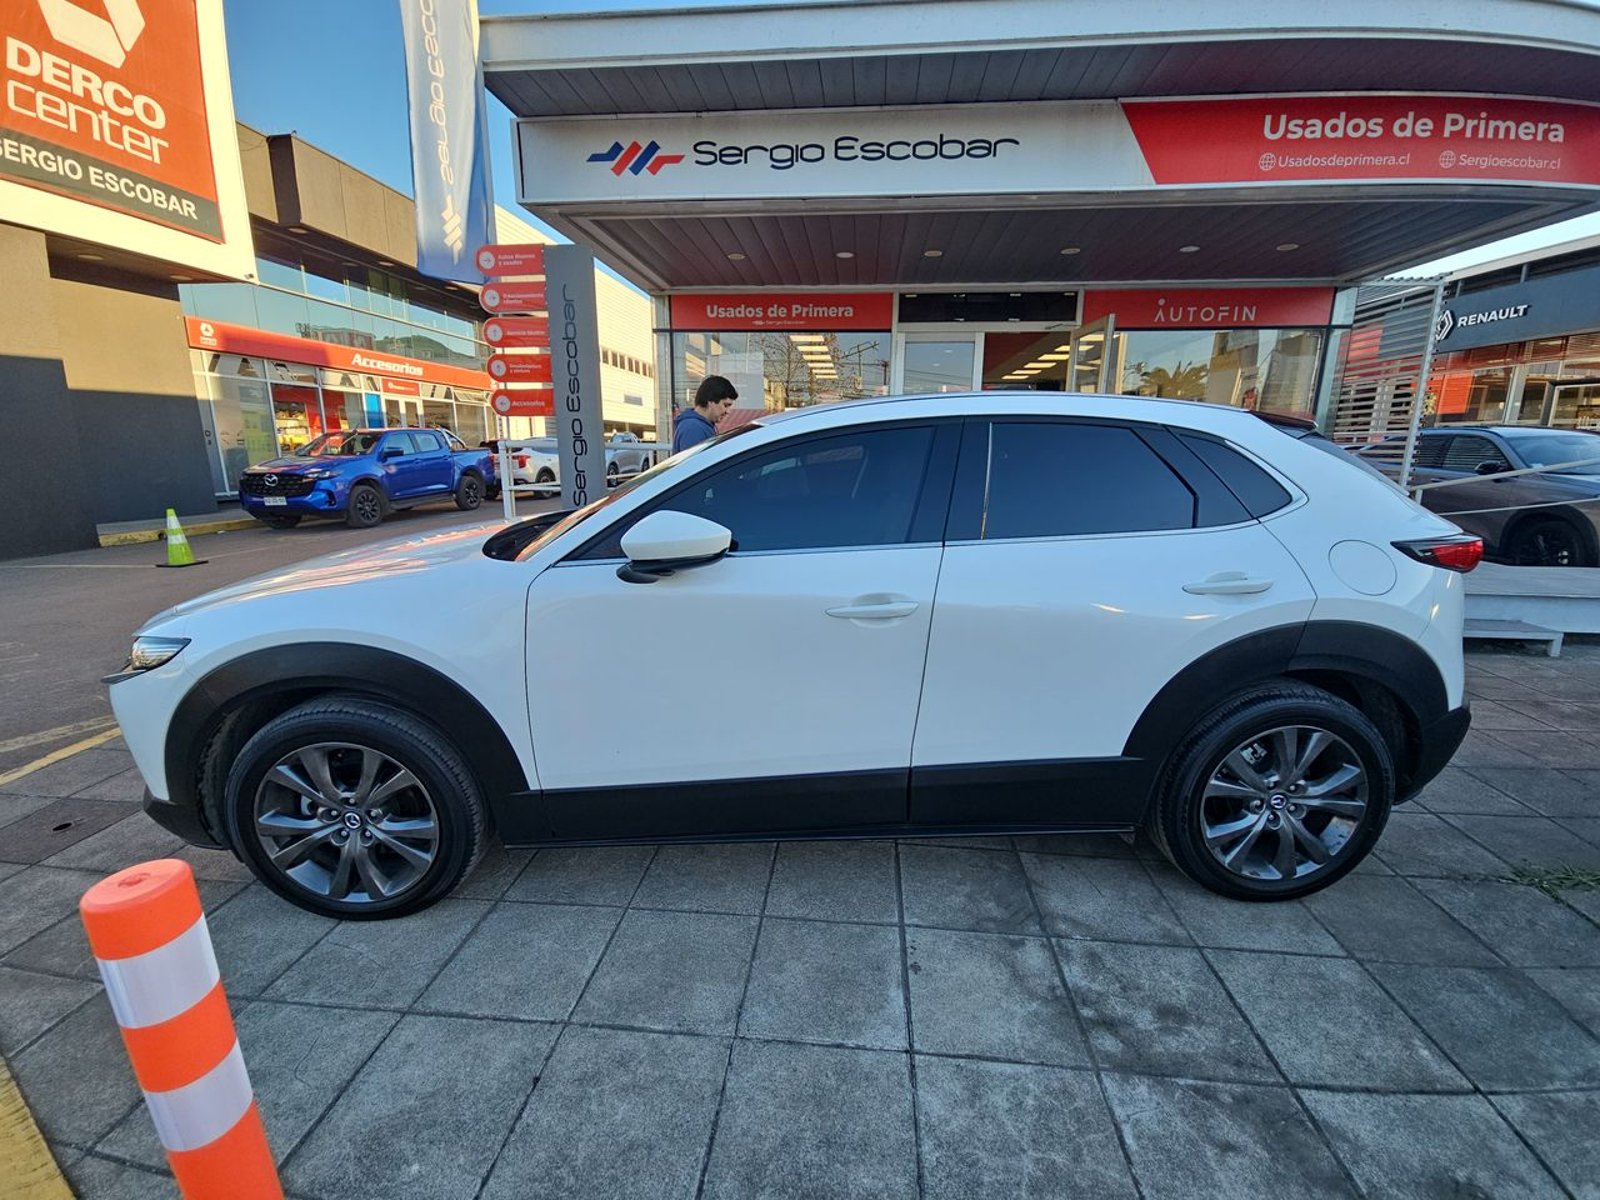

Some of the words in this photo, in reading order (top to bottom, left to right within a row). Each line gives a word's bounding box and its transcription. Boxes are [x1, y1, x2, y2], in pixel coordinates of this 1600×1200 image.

[6, 36, 167, 129] DERCO
[7, 79, 169, 165] center
[1263, 111, 1384, 140] Usados
[1392, 111, 1434, 138] de
[1443, 112, 1565, 144] Primera
[693, 140, 825, 170] Sergio
[834, 134, 1020, 162] Escobar
[1277, 153, 1410, 169] Usadosdeprimera.cl
[1459, 153, 1561, 170] Sergioescobar.cl
[0, 138, 83, 181] ERGIO
[88, 165, 198, 220] ESCOBAR
[706, 304, 764, 319] Usados
[767, 304, 788, 318] de
[791, 303, 854, 318] Primera
[1154, 299, 1257, 322] AUTOFIN
[1456, 304, 1529, 328] RENAULT
[351, 353, 424, 376] Accesorios
[562, 283, 581, 413] Escobar
[571, 418, 588, 507] Sergio
